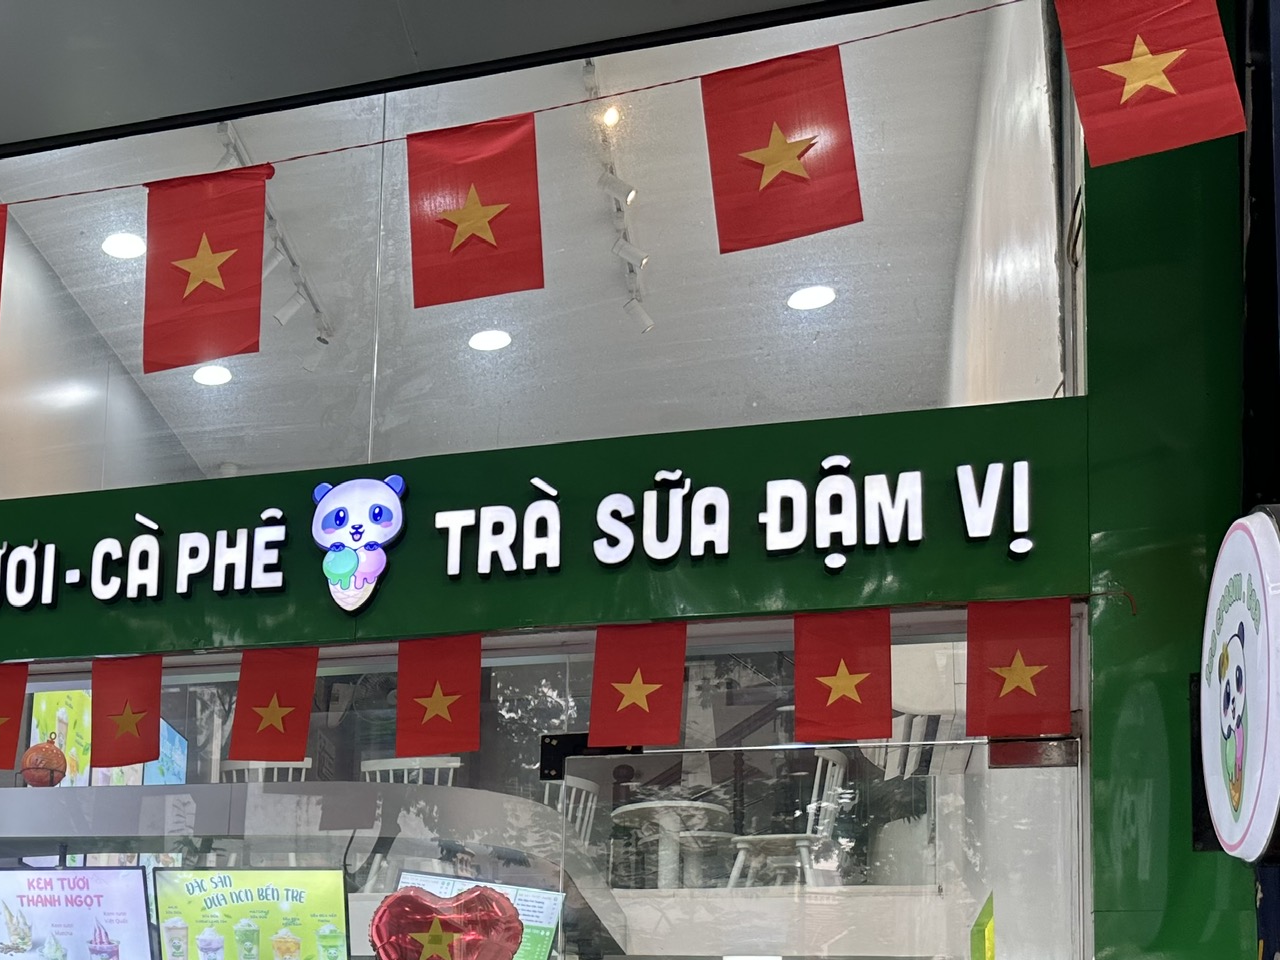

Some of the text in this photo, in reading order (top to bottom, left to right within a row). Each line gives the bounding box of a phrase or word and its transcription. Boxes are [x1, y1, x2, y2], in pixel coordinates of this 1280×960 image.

[435, 455, 1034, 576] TRÀ SỮA ĐẬM VỊ
[176, 508, 284, 593] PHÊ
[27, 877, 90, 891] KEM TƯƠI
[17, 894, 62, 908] THANH
[283, 887, 306, 904] TRE
